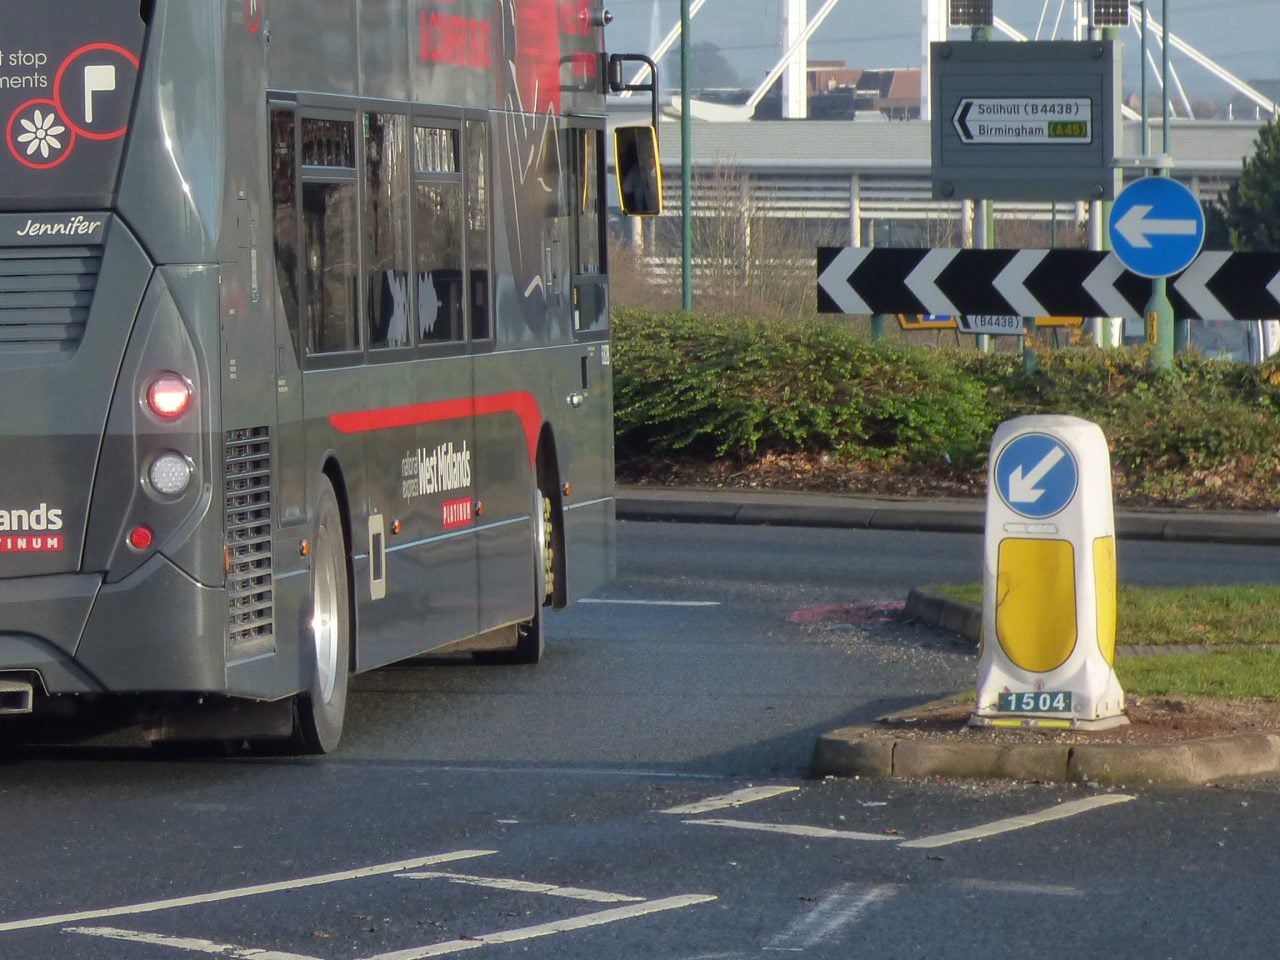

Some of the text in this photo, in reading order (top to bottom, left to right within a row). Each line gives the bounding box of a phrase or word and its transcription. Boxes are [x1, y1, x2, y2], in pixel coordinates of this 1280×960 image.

[9, 50, 48, 68] stop
[977, 102, 1080, 116] Solihull (B4438)
[978, 124, 1044, 137] Birmingham
[16, 215, 102, 236] Jennifer
[974, 315, 1020, 329] (B4438)
[418, 439, 471, 496] West Midlands
[1007, 692, 1066, 711] 1504
